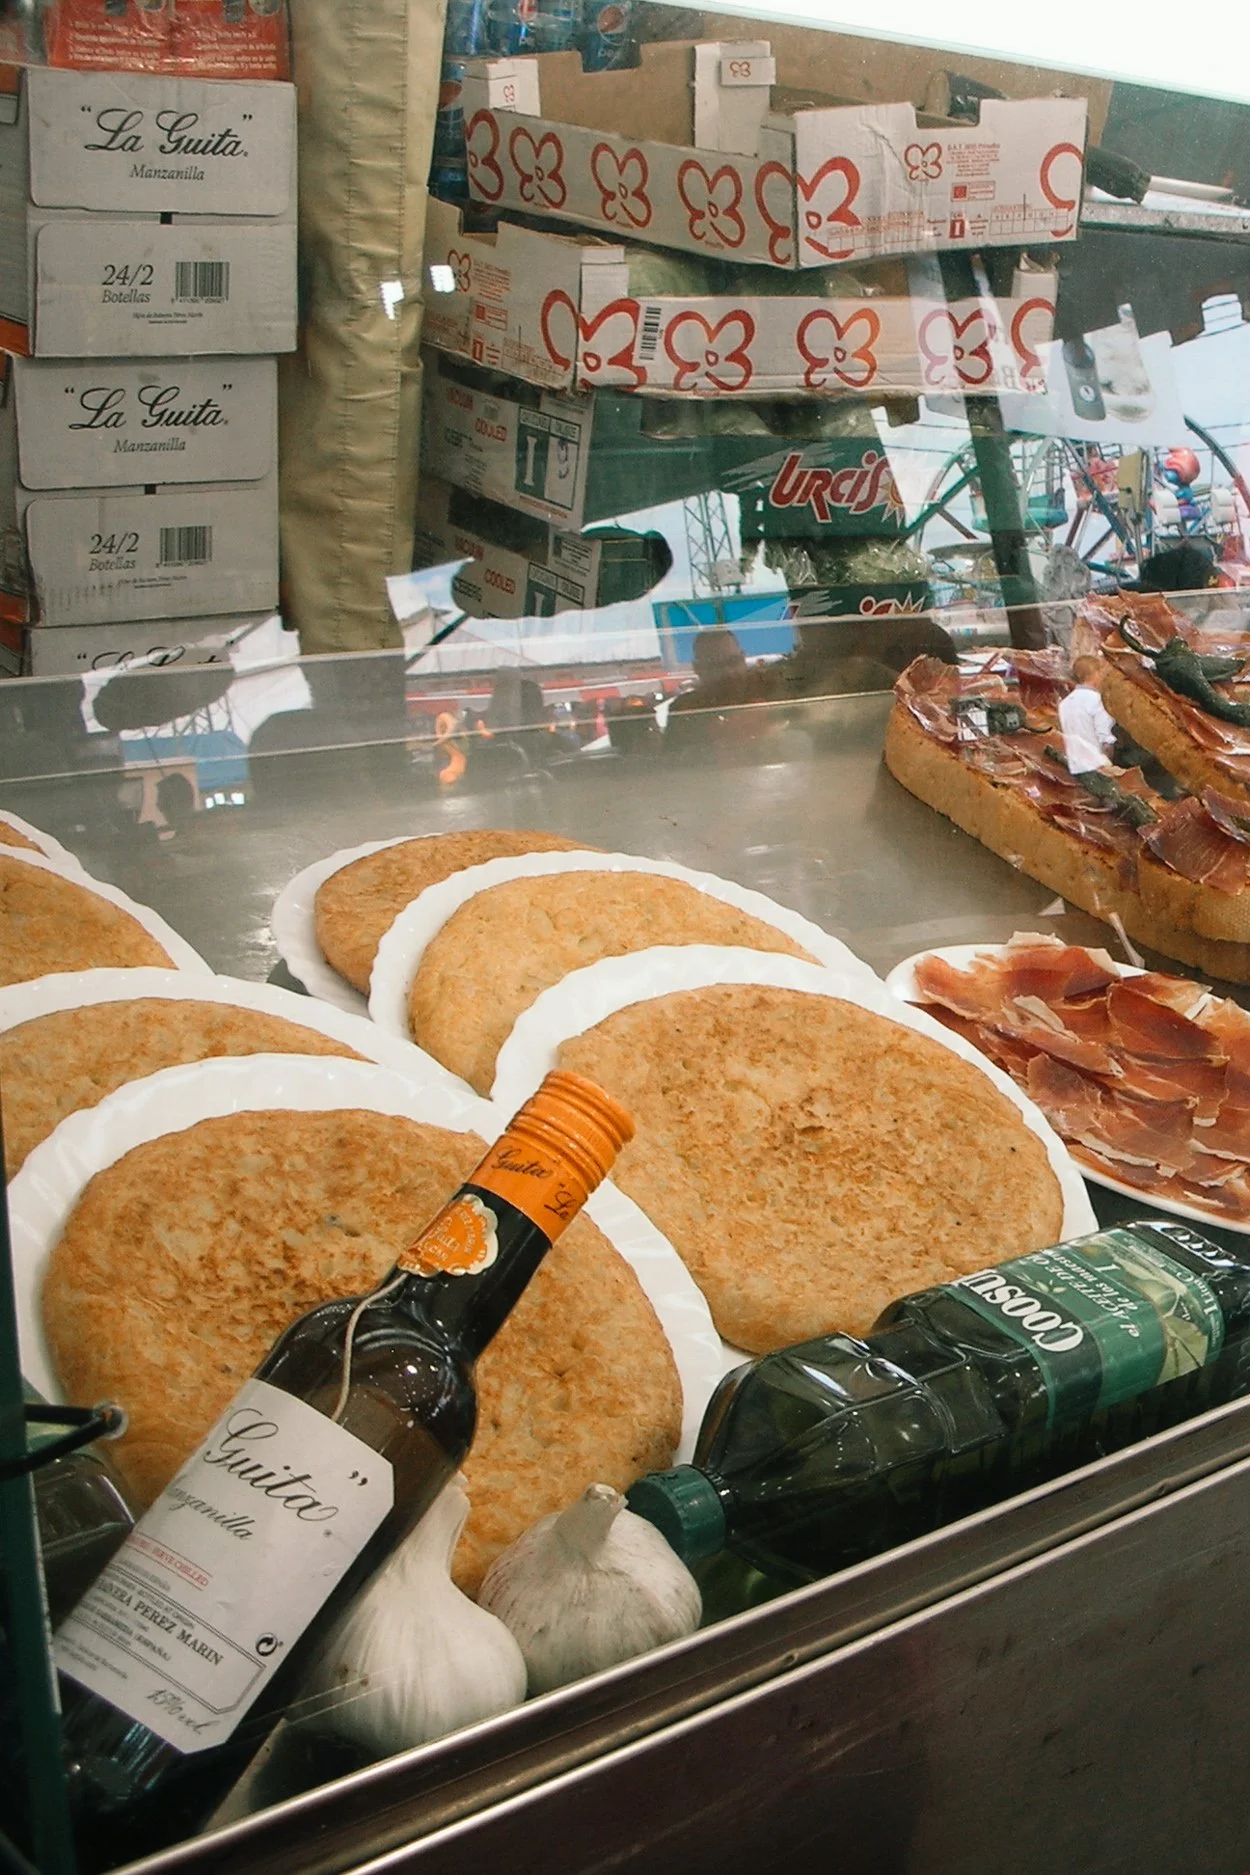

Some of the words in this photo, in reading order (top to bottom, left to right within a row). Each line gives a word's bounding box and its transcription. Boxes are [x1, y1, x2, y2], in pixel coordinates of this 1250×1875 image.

[130, 164, 205, 181] Manzanilla
[101, 264, 154, 287] 24/2
[102, 289, 151, 304] Botellas
[113, 437, 187, 453] Manzanilla
[88, 532, 140, 555] 24/2
[88, 557, 137, 572] Botellas
[1044, 1265, 1076, 1281] DE
[1095, 1282, 1120, 1297] los
[1068, 1280, 1131, 1320] ACEITE
[1116, 1297, 1139, 1311] de
[133, 1600, 177, 1635] PEREZ
[176, 1629, 225, 1667] MARIN
